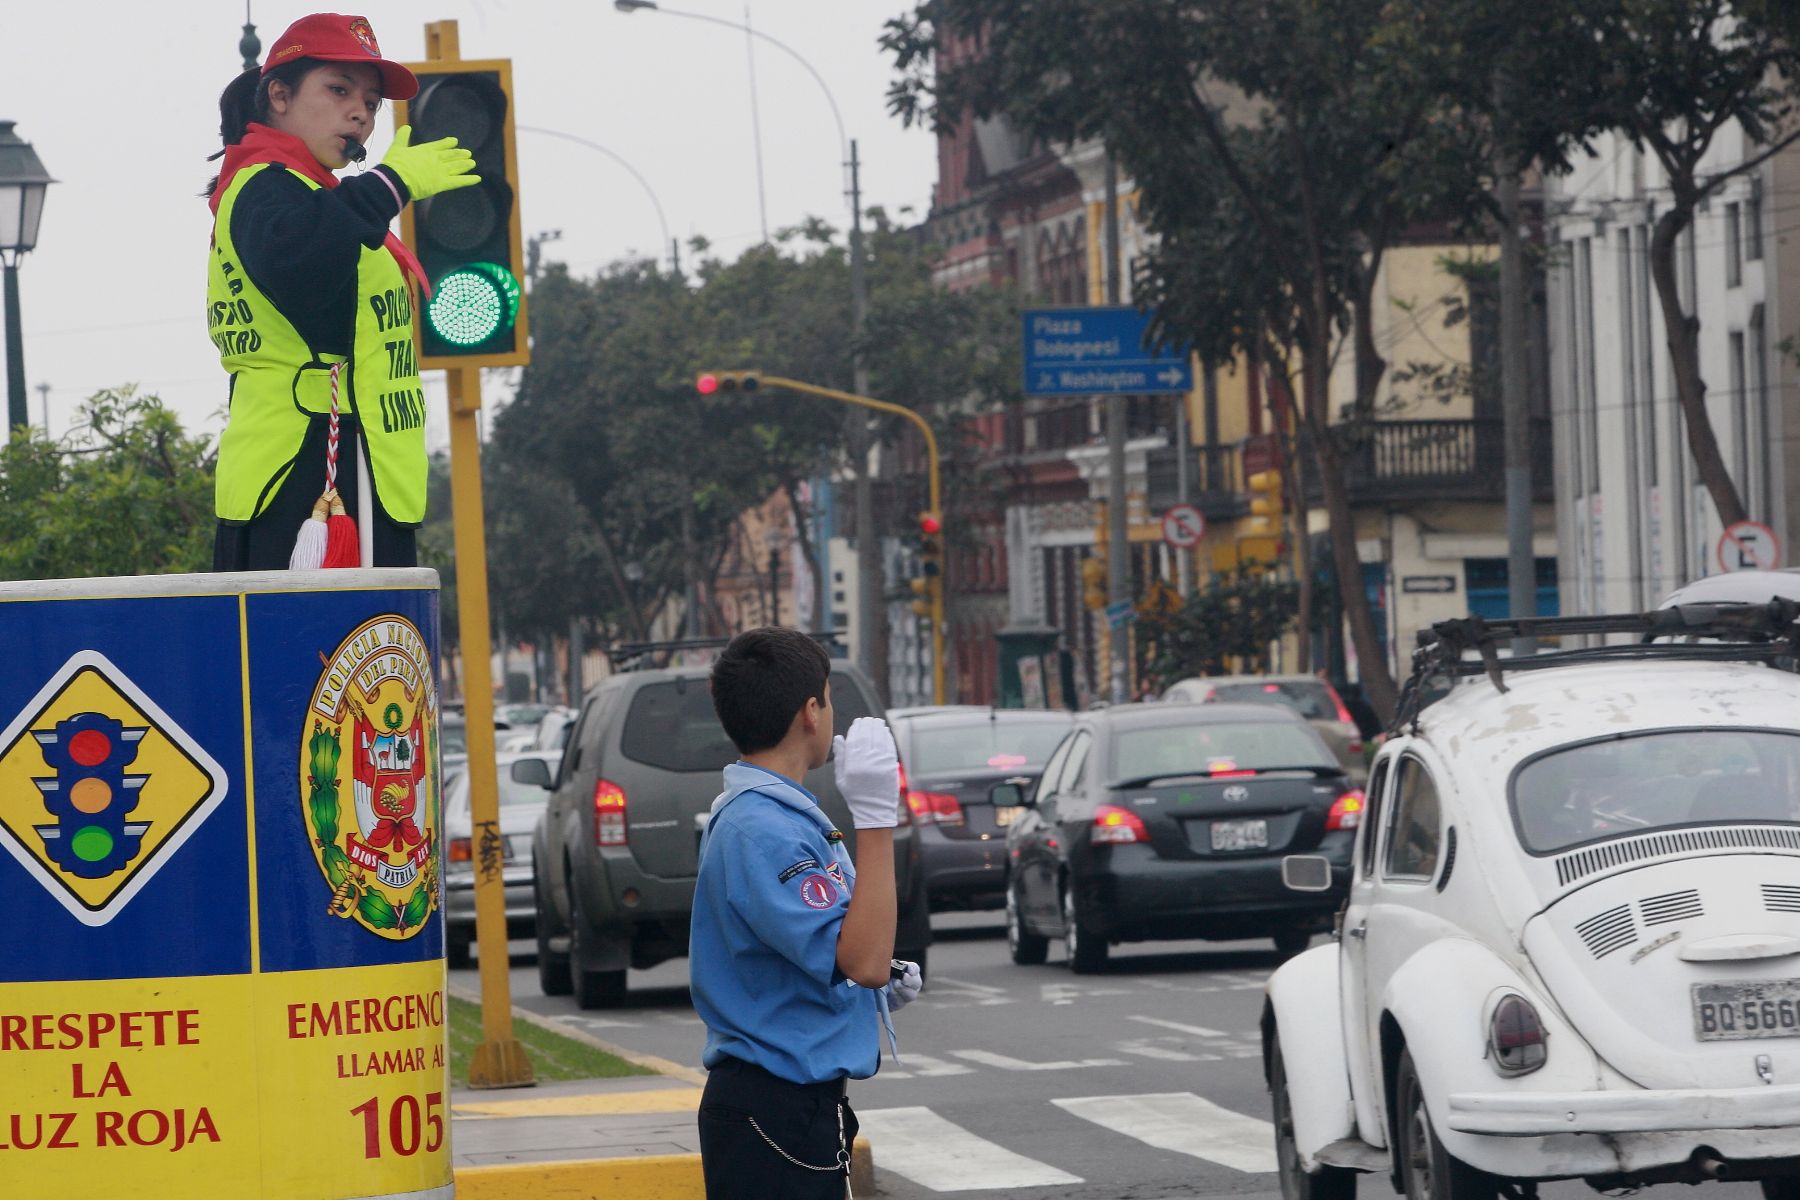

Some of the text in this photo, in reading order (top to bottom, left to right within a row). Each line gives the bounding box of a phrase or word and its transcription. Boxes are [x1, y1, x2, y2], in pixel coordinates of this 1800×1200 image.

[1034, 317, 1082, 334] Plaza
[1034, 338, 1120, 361] Bolognesi
[1060, 371, 1146, 391] Washington
[379, 390, 421, 433] LIMA
[319, 628, 382, 711] POLICIA
[361, 659, 387, 688] DEL
[351, 845, 377, 867] DIOS
[417, 842, 429, 863] LEY
[384, 866, 413, 884] PATRIA
[1, 1009, 200, 1051] RESPETE
[337, 1044, 445, 1079] LLAMAR AL
[72, 1061, 132, 1099] LA
[96, 1106, 221, 1153] ROJA
[350, 1091, 444, 1160] 105
